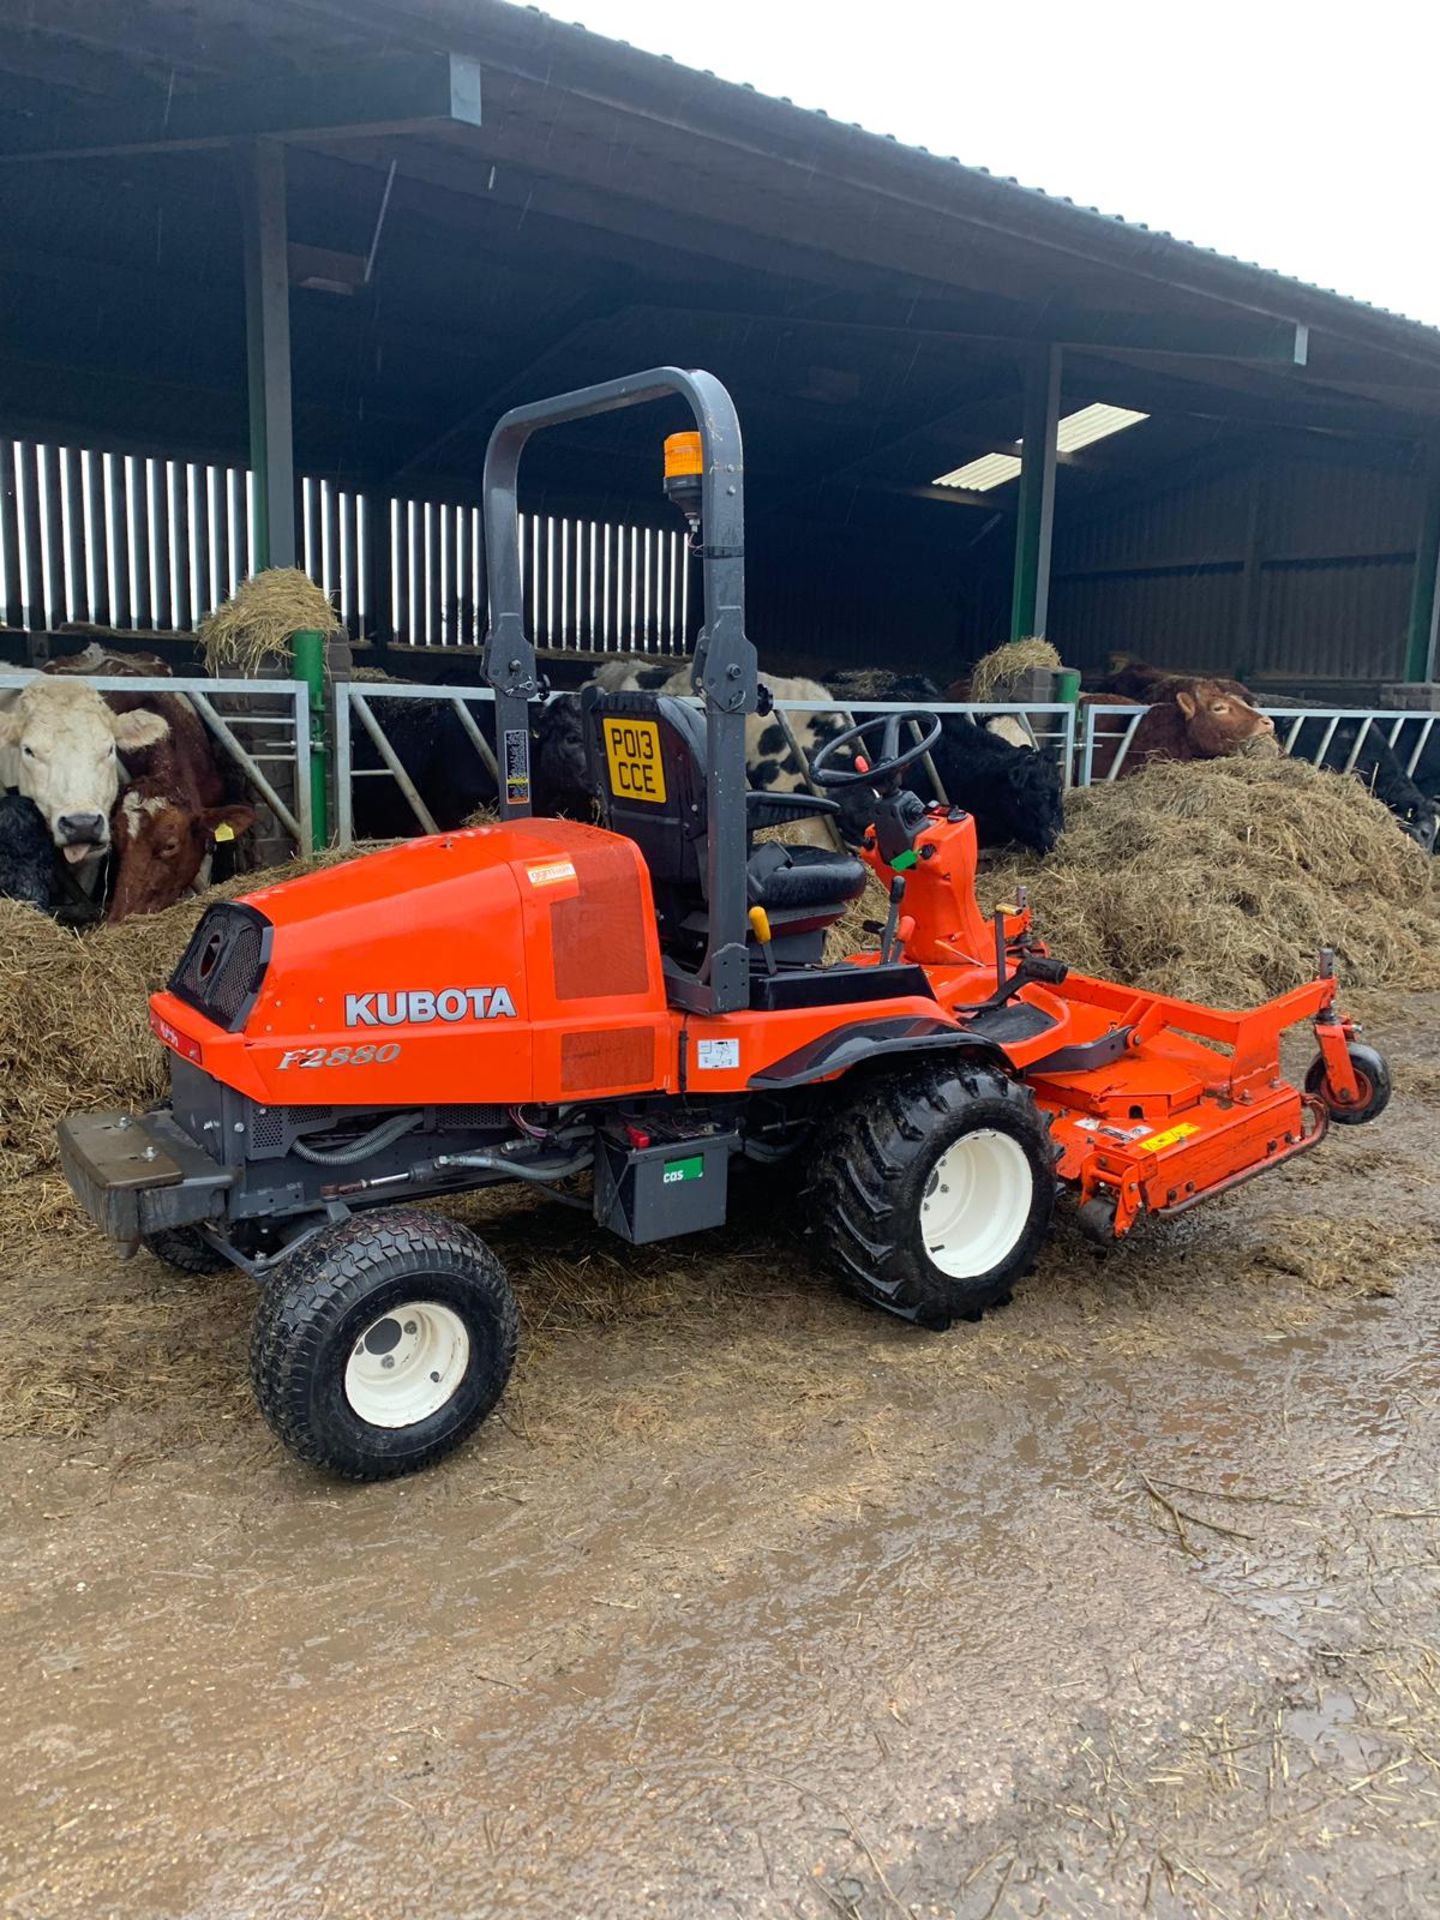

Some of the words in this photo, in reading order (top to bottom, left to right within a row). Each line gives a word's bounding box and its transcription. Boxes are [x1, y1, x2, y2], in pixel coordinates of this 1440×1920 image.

[611, 728, 654, 760] PO13
[618, 761, 656, 794] CCE
[345, 985, 517, 1027] KUBOTA
[274, 1043, 401, 1070] F2880
